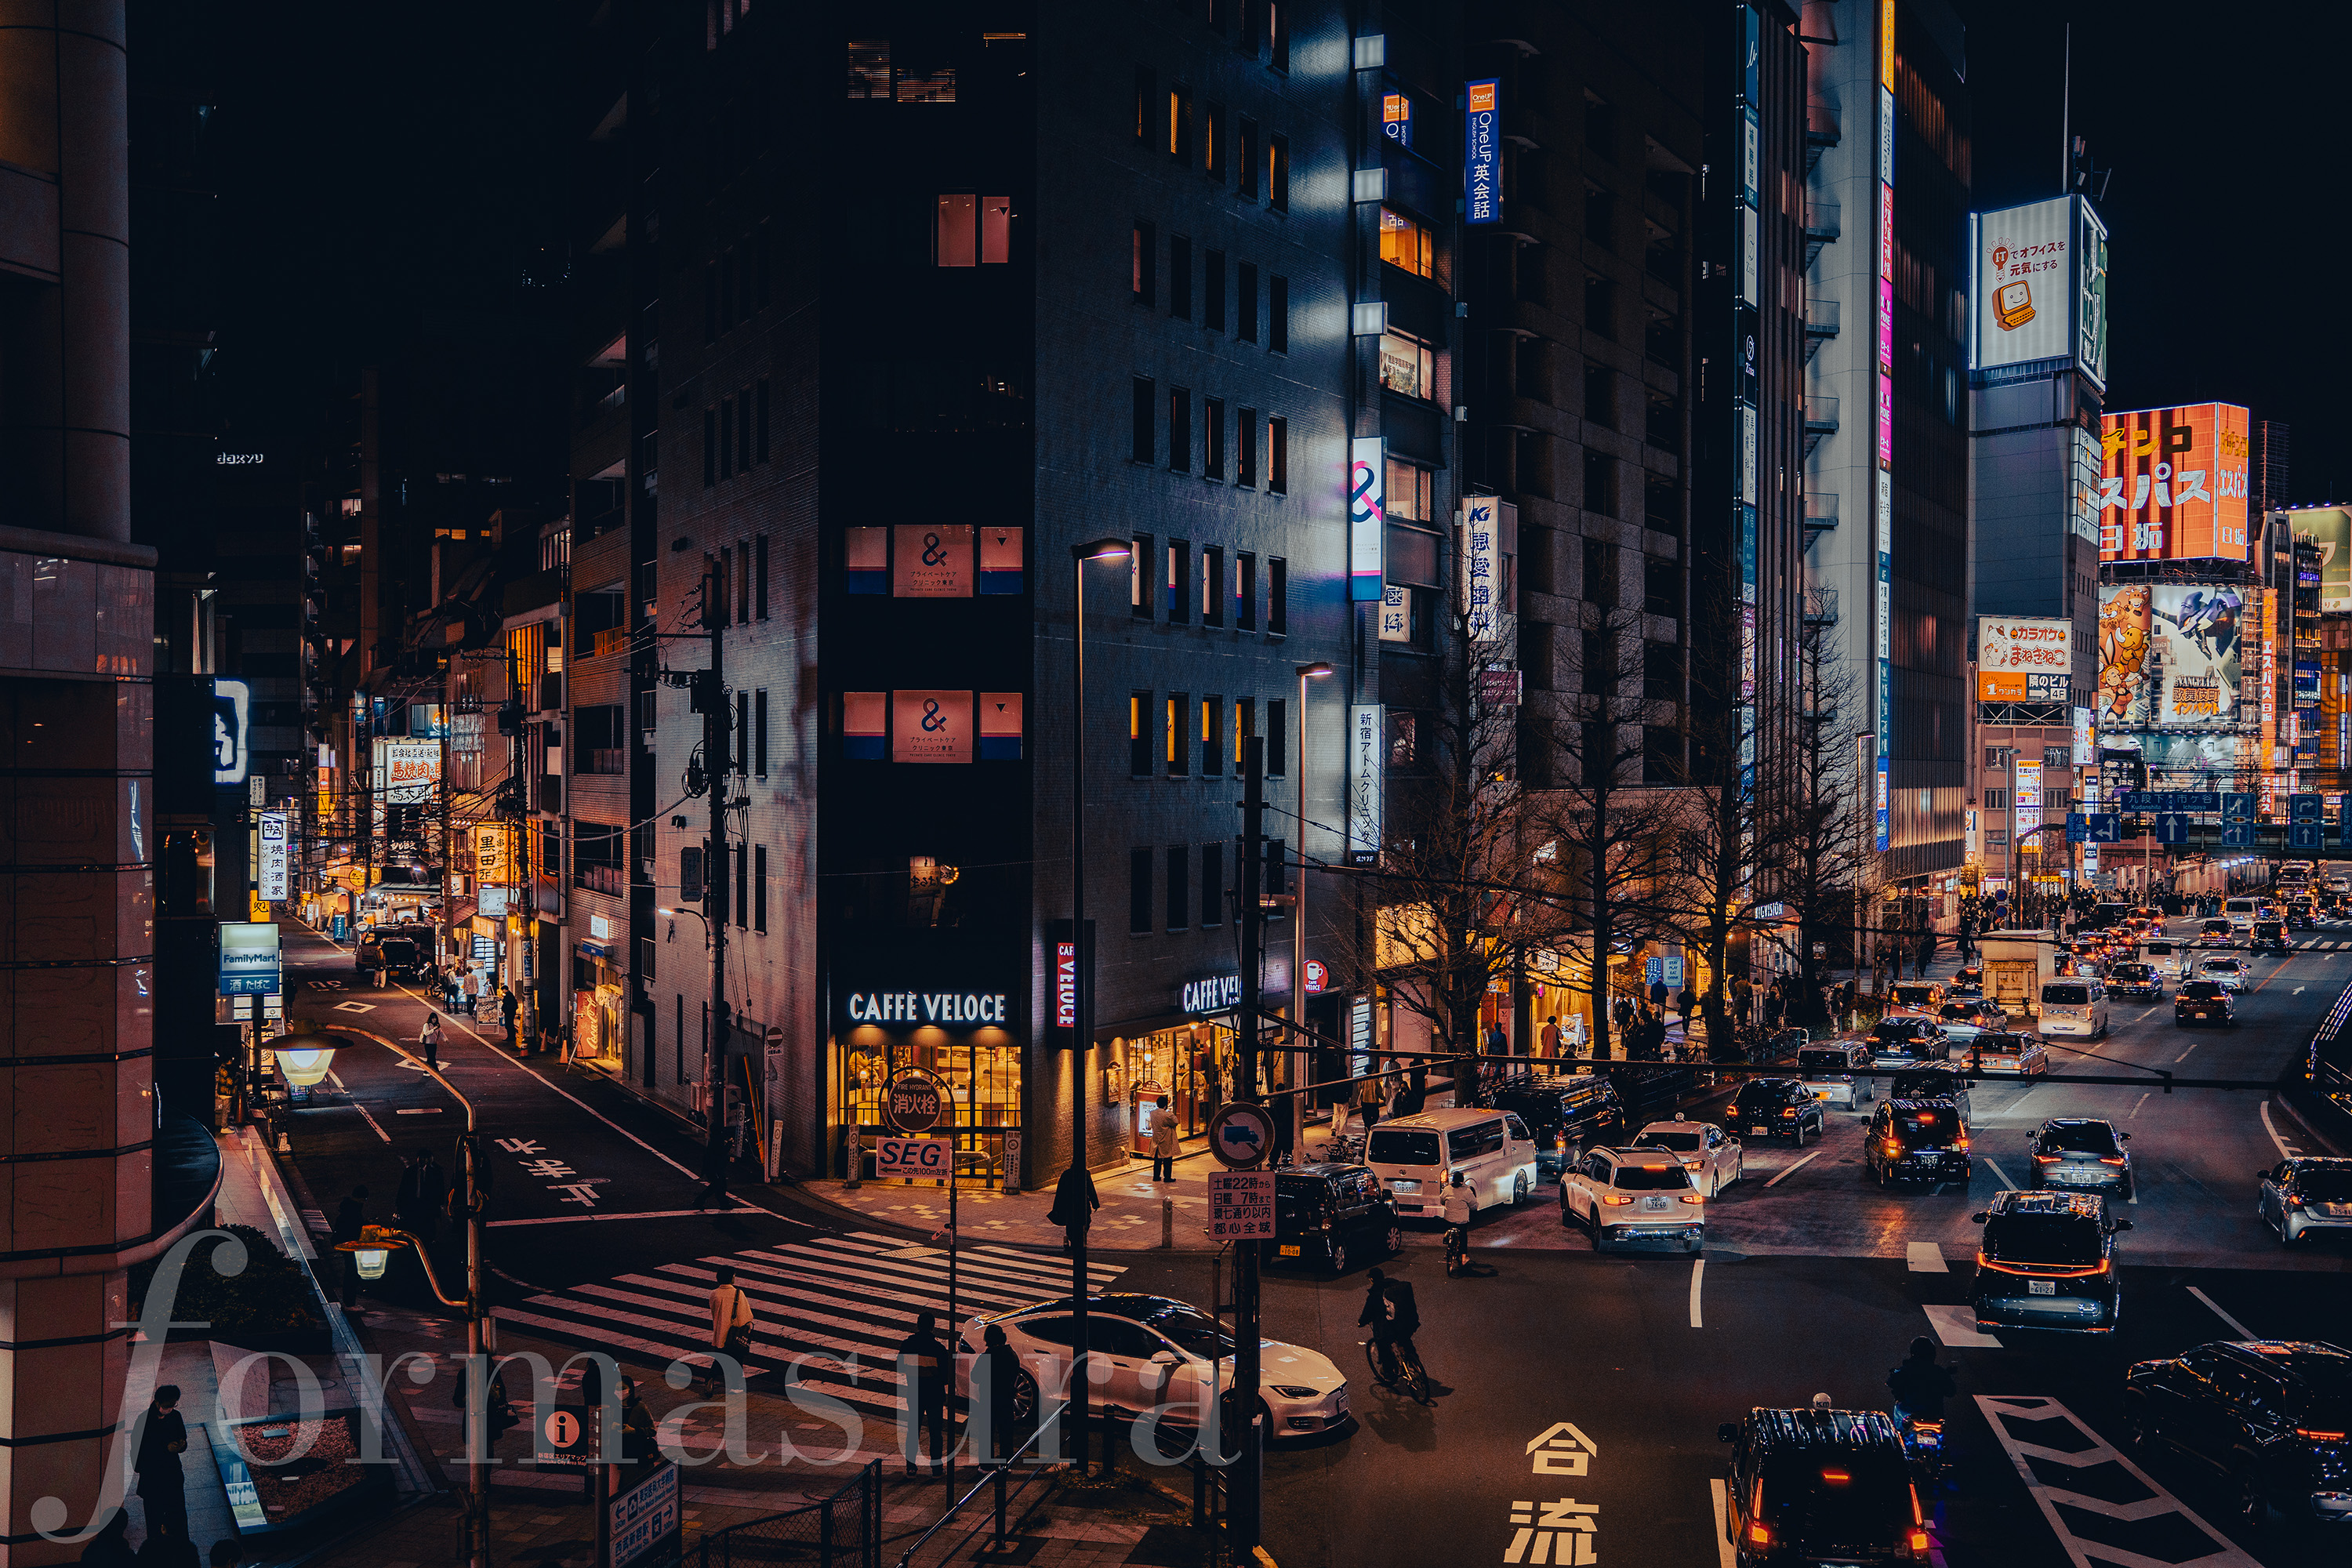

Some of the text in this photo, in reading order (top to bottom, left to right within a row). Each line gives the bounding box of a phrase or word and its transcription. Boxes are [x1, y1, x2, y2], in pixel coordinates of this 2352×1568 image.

[1472, 93, 1492, 101] OneUP
[1474, 112, 1492, 219] OneUP 英会話
[1995, 241, 2065, 262] IT でオフィスを
[2009, 260, 2058, 277] 元気にする
[2220, 464, 2248, 499] エスパス
[2222, 526, 2245, 546] 日拓
[2299, 572, 2319, 581] SHISHA
[2017, 626, 2059, 641] カラオケ
[2010, 644, 2066, 666] まねきねこ
[2263, 595, 2273, 721] パチンコ エスパス 日拓
[2029, 674, 2069, 688] 隣のビル
[2052, 690, 2065, 699] 4F
[2172, 688, 2220, 702] 歌舞伎町
[2172, 702, 2220, 715] インパクト
[1360, 713, 1372, 843] 新宿アトムクリニック
[2262, 739, 2271, 812] パチンコ エスパス
[2129, 794, 2164, 804] 九段下
[479, 835, 496, 866] 黒田
[270, 844, 284, 895] 焼肉酒家
[479, 871, 491, 880] 2F
[223, 953, 276, 964] FamilyMart
[229, 979, 270, 992] 酒 たばこ
[1059, 960, 1075, 1025] VELOCE
[1183, 975, 1218, 1012] CAFFÈ
[849, 990, 1005, 1021] CAFFÈ VELOCE
[893, 1094, 936, 1115] 消火栓
[879, 1142, 942, 1167] SEG
[902, 1167, 948, 1176] この先100m左折
[1213, 1177, 1271, 1190] 土曜22時から
[1214, 1192, 1271, 1205] 日曜 7時まで
[1213, 1207, 1271, 1220] 環七通り以内
[1213, 1221, 1271, 1235] 都心全域
[538, 1452, 587, 1461] 新宿区エリアマップ
[1503, 1421, 1599, 1566] 合流
